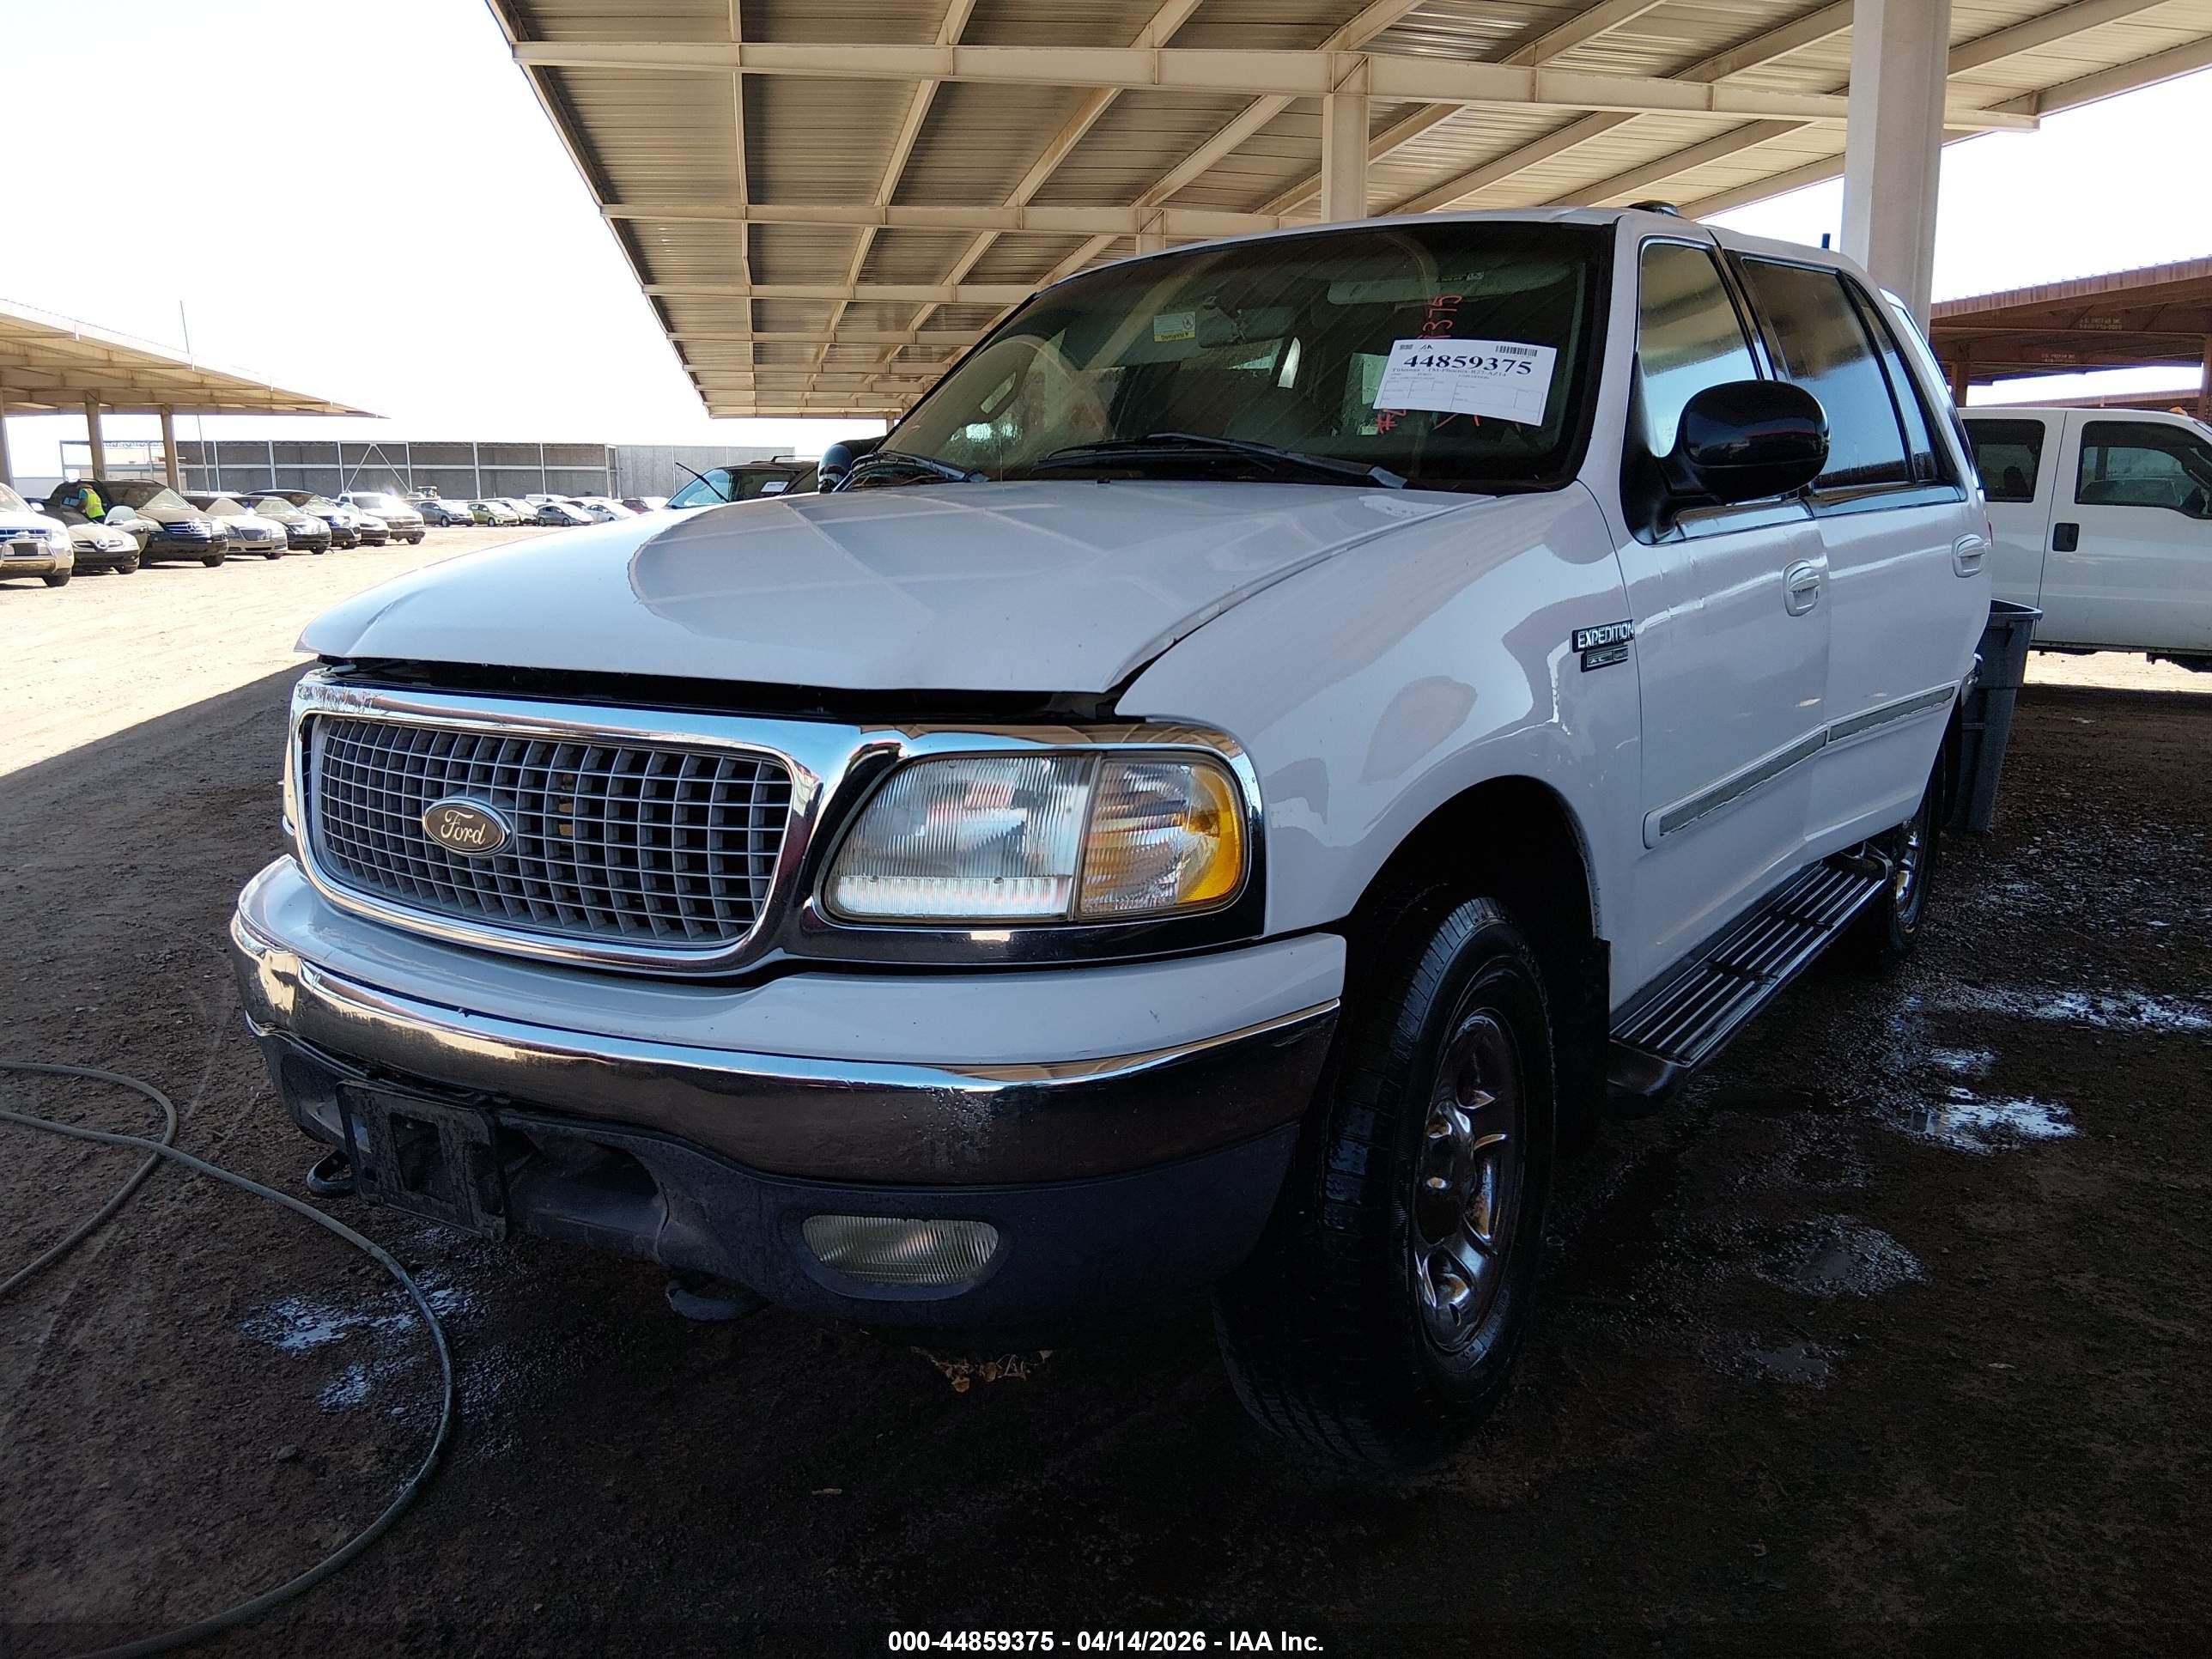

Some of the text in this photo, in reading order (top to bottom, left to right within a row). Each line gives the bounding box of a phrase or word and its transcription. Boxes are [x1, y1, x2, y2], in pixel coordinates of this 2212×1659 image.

[1403, 355, 1533, 375] 44859375
[1577, 622, 1635, 648] EXPEDITION
[441, 810, 486, 845] Ford
